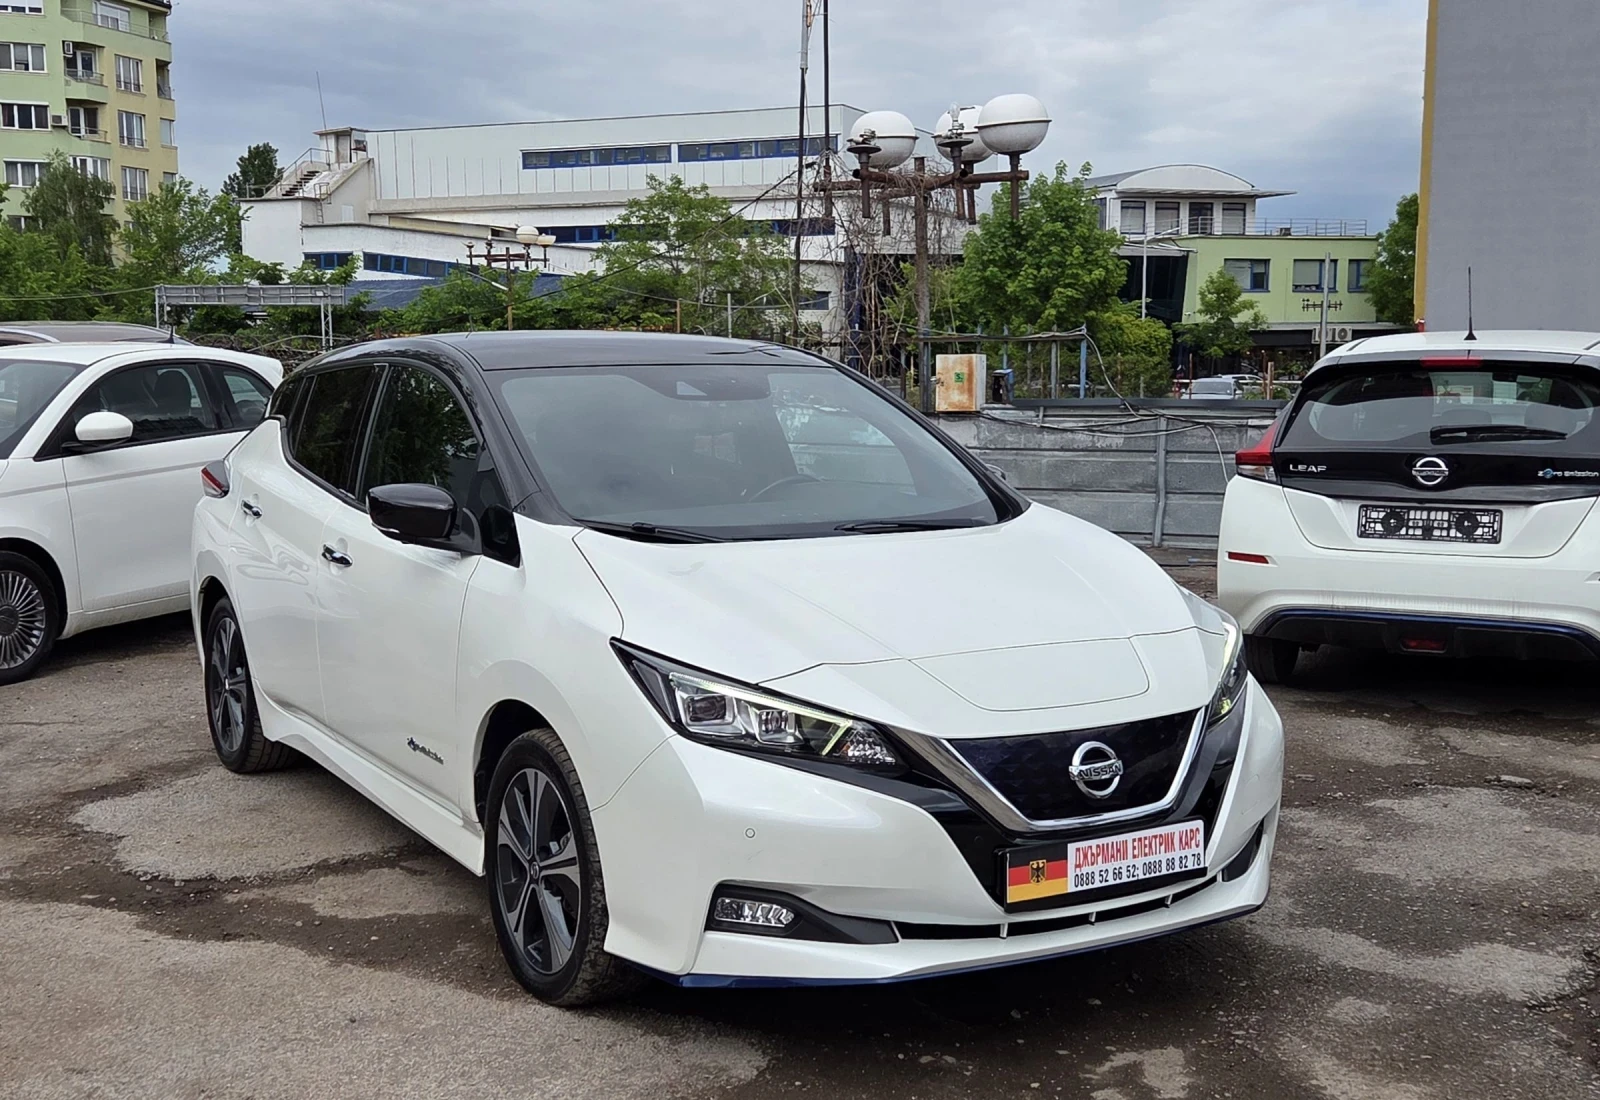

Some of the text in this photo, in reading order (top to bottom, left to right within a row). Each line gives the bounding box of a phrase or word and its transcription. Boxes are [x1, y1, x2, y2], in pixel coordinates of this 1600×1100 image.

[1289, 464, 1327, 472] LEAF
[1080, 761, 1121, 778] NISSAN
[1074, 827, 1201, 872] ДЖЪРМАНИ ЕЛЕКТРИК КАРС
[1074, 852, 1202, 888] 0888 52 66 52; 0888 88 82 78
